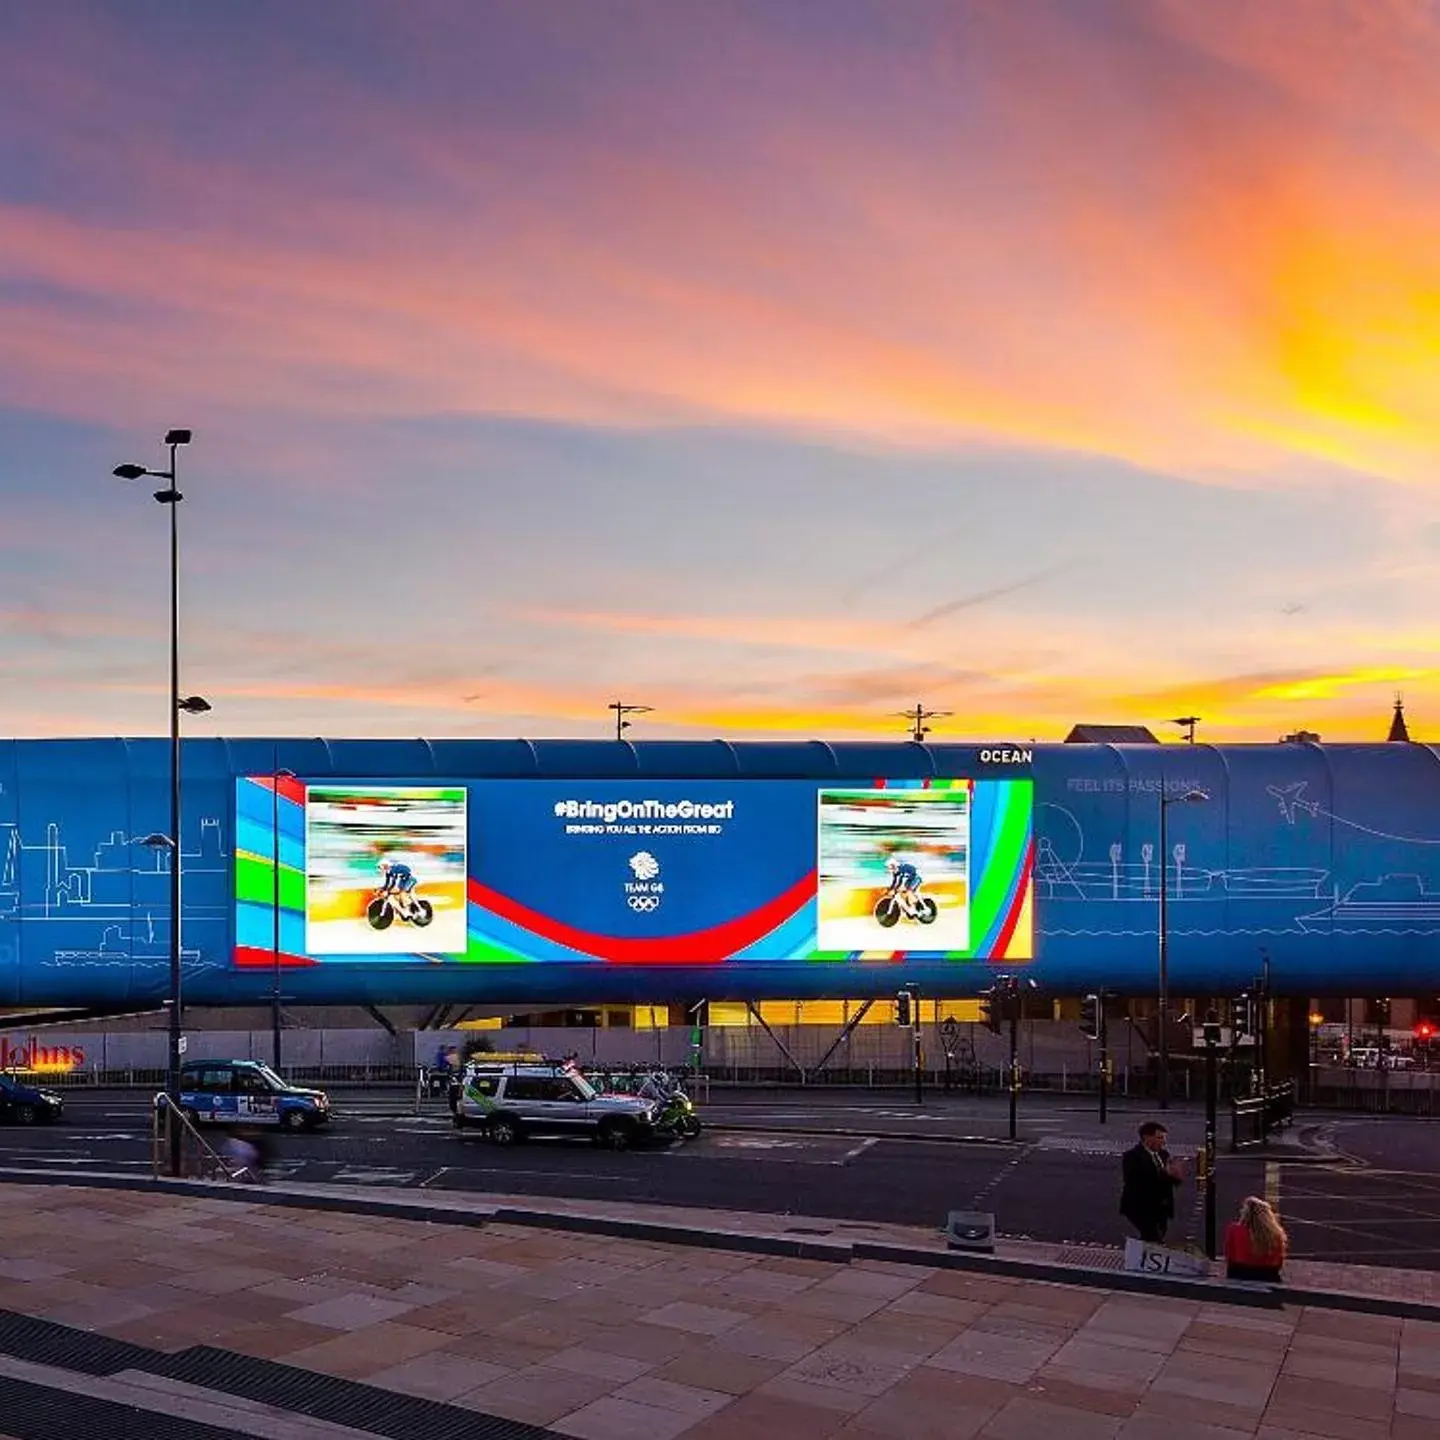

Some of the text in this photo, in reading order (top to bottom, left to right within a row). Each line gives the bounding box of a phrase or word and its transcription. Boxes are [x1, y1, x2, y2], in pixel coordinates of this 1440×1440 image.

[980, 750, 1032, 763] OCEAN
[1067, 778, 1100, 792] FEEL
[1103, 778, 1124, 792] ITS
[554, 799, 735, 823] #BringOnTheGreat
[605, 824, 623, 834] YOU
[623, 824, 637, 834] ALL
[637, 824, 652, 834] THE
[652, 824, 682, 834] ACTION
[683, 824, 707, 834] FROM
[624, 882, 649, 893] TEAM
[0, 1035, 86, 1072] Johns
